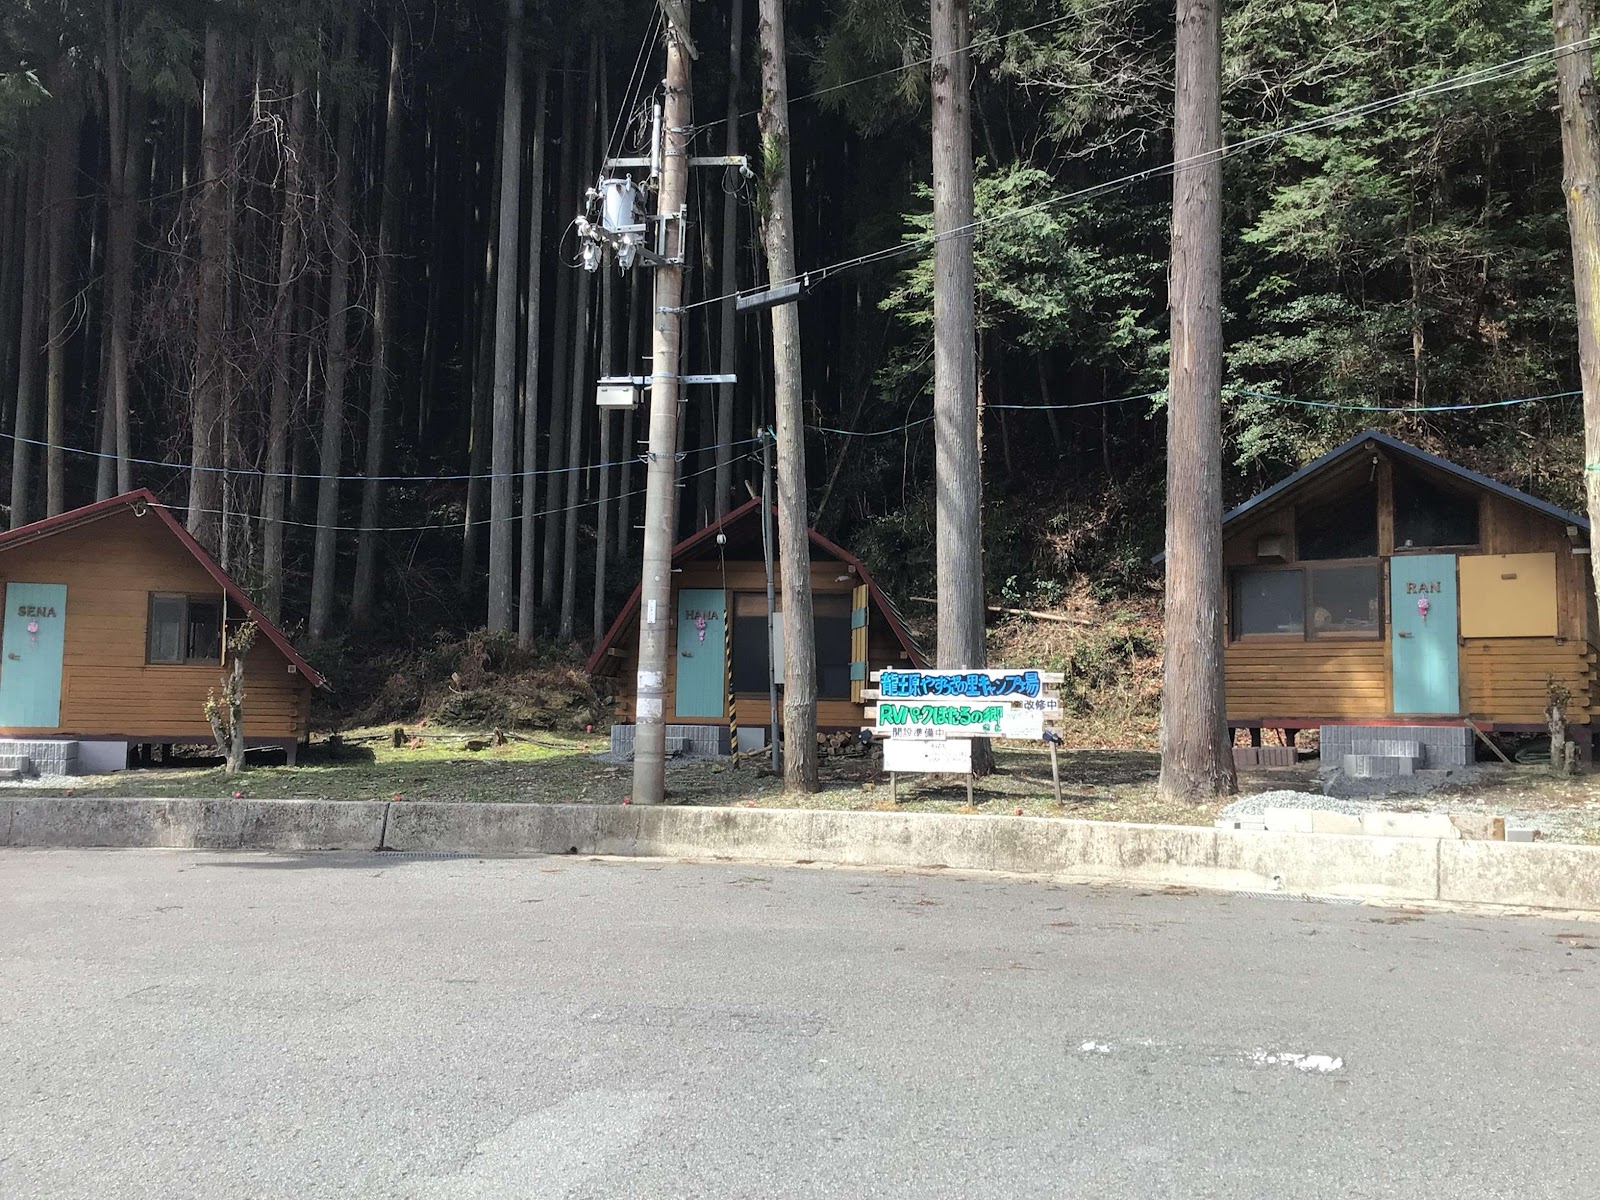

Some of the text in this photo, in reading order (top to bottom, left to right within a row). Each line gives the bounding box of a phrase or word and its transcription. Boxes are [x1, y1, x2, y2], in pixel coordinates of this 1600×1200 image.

[1406, 582, 1441, 594] RAN
[18, 606, 57, 618] SENA
[685, 610, 719, 620] HANA
[880, 672, 1041, 698] 龍王原やすらぎの里キャンプ場
[1024, 699, 1057, 711] 改修中
[880, 704, 1004, 726] RVパークほたるの郷
